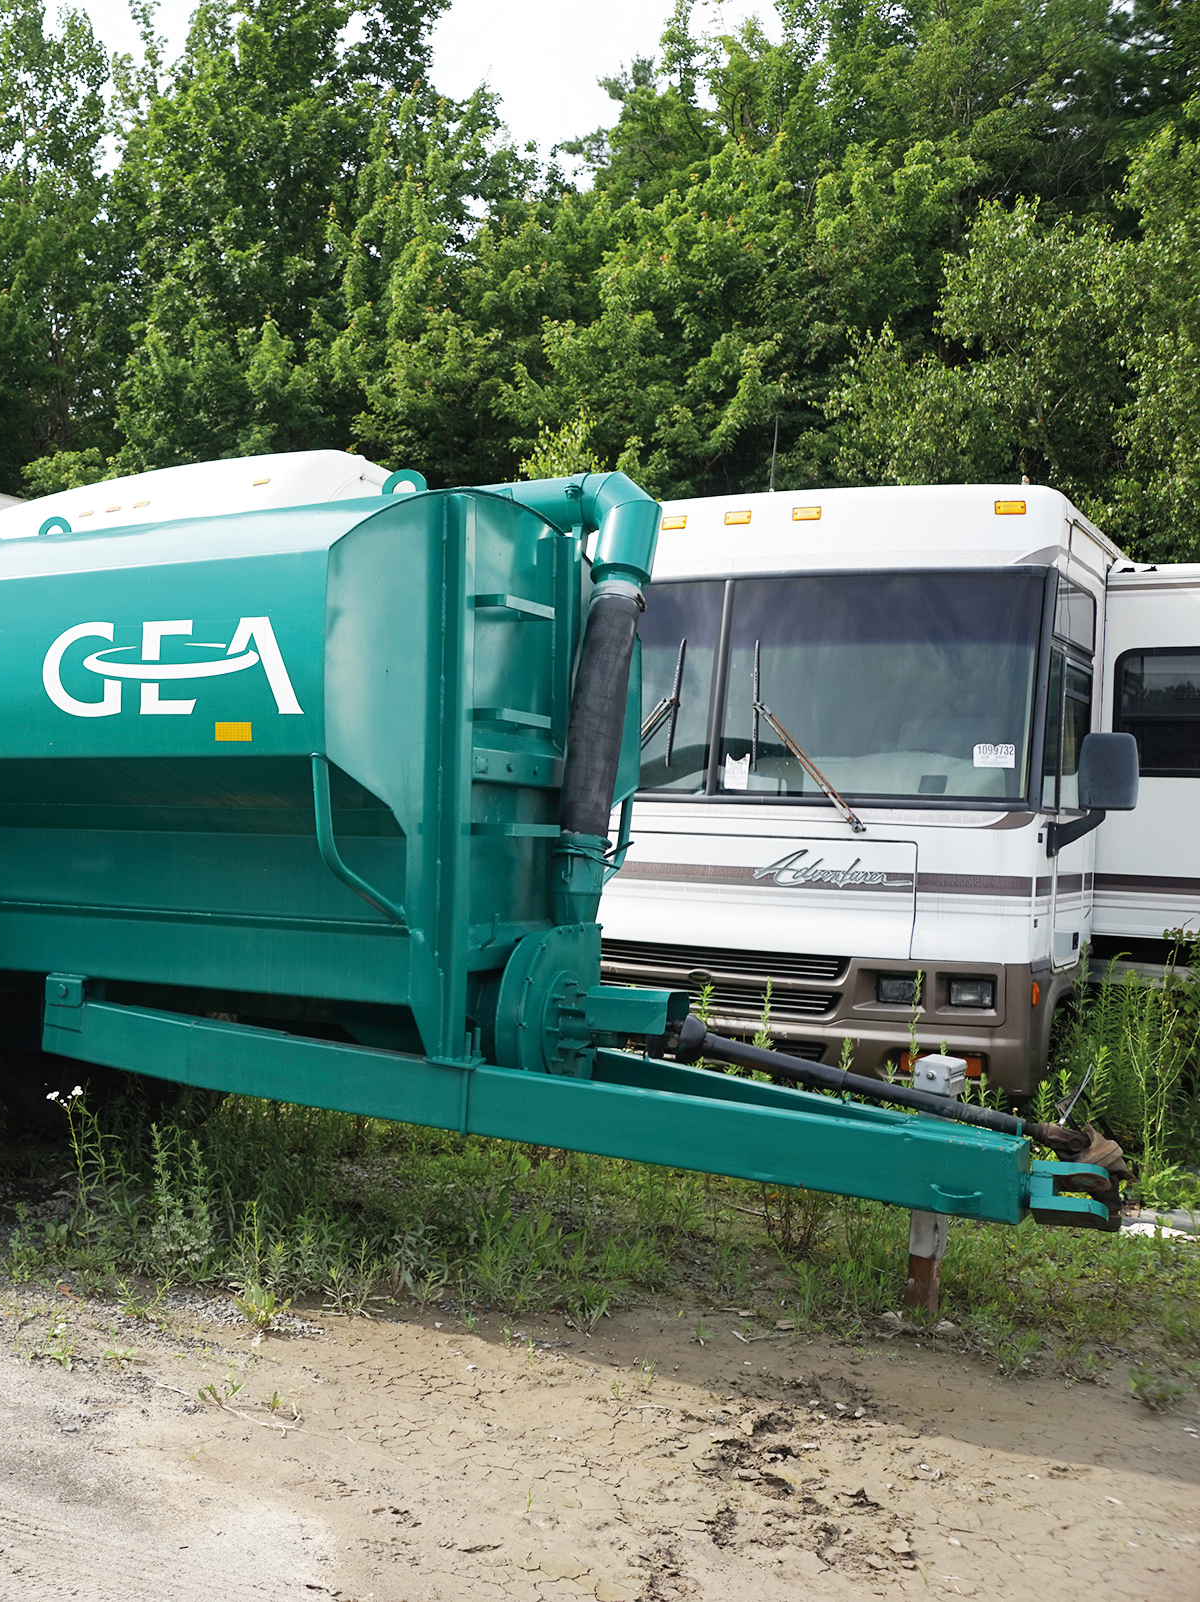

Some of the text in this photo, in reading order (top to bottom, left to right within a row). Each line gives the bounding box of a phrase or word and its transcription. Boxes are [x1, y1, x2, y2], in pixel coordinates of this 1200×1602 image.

[42, 616, 304, 717] GEA
[977, 745, 1015, 756] 1099732
[752, 848, 913, 889] Adventurer
